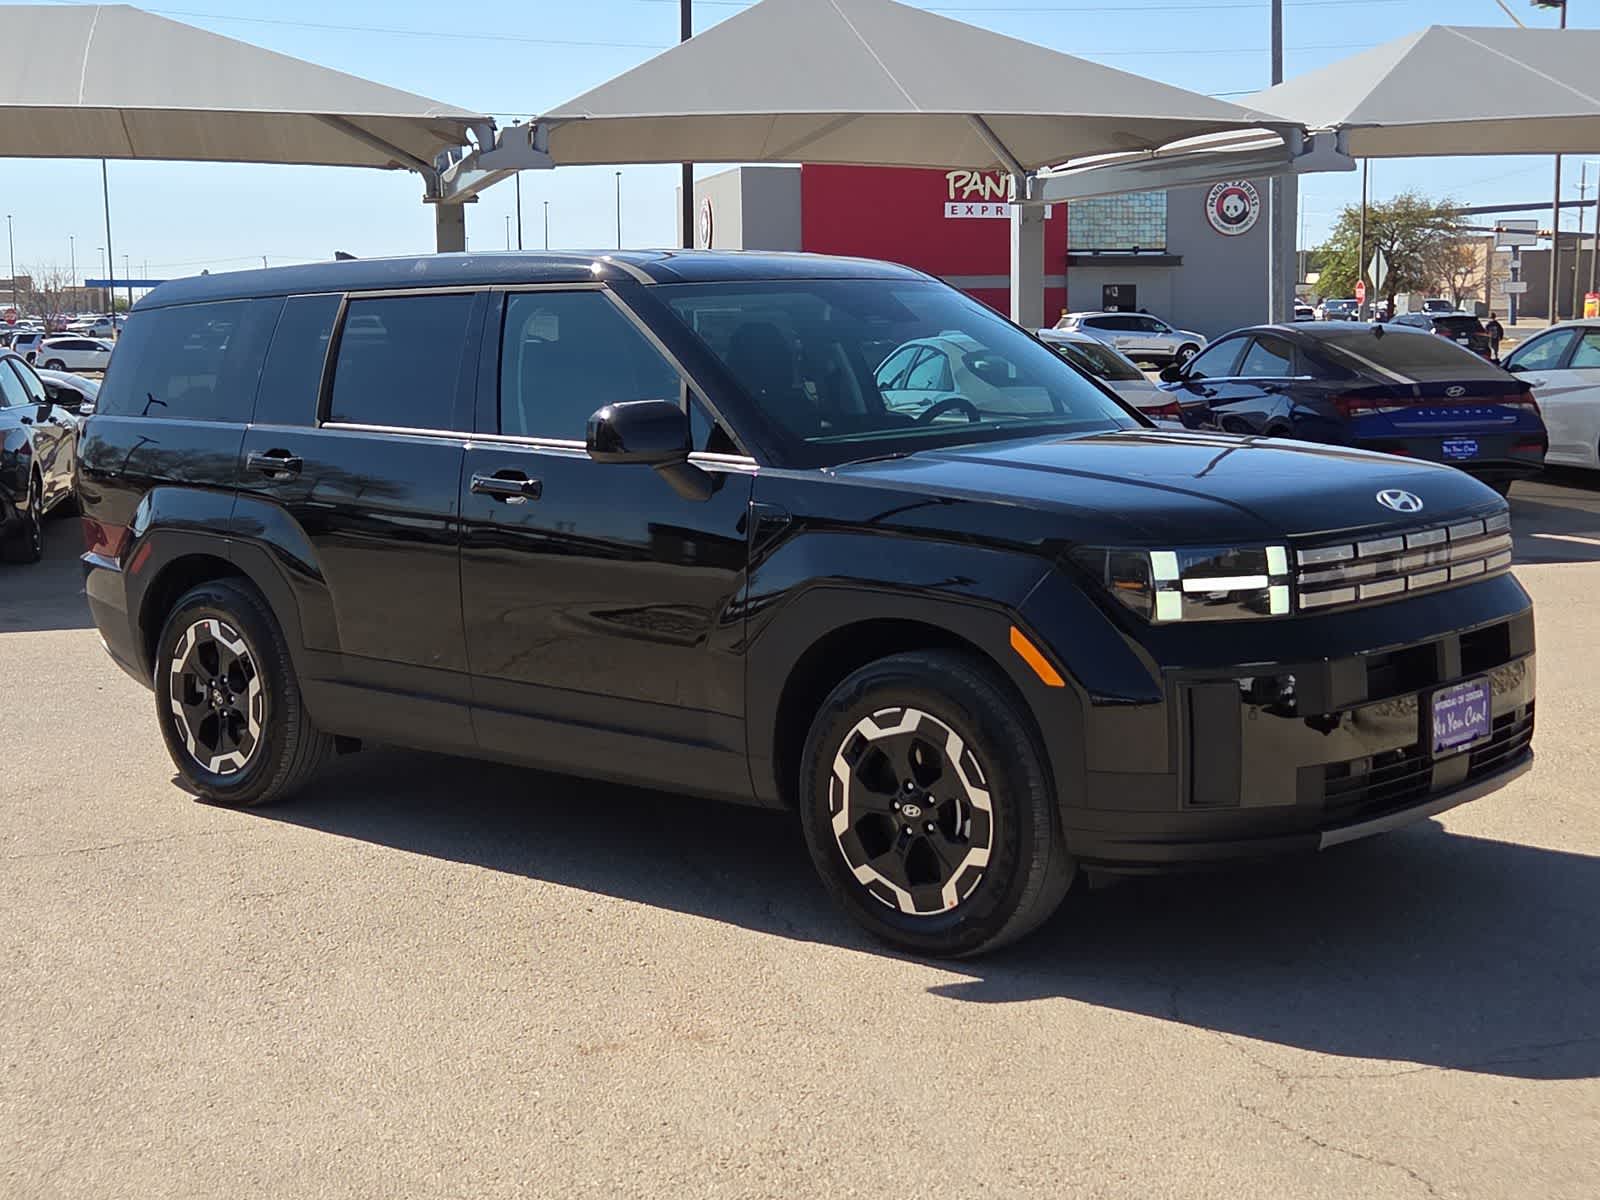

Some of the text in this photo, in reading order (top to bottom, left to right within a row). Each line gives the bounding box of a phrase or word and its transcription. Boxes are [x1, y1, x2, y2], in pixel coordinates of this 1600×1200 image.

[945, 170, 1009, 201] PAN
[1208, 181, 1259, 208] PANDA EXPRESS
[950, 205, 1004, 216] EXPR
